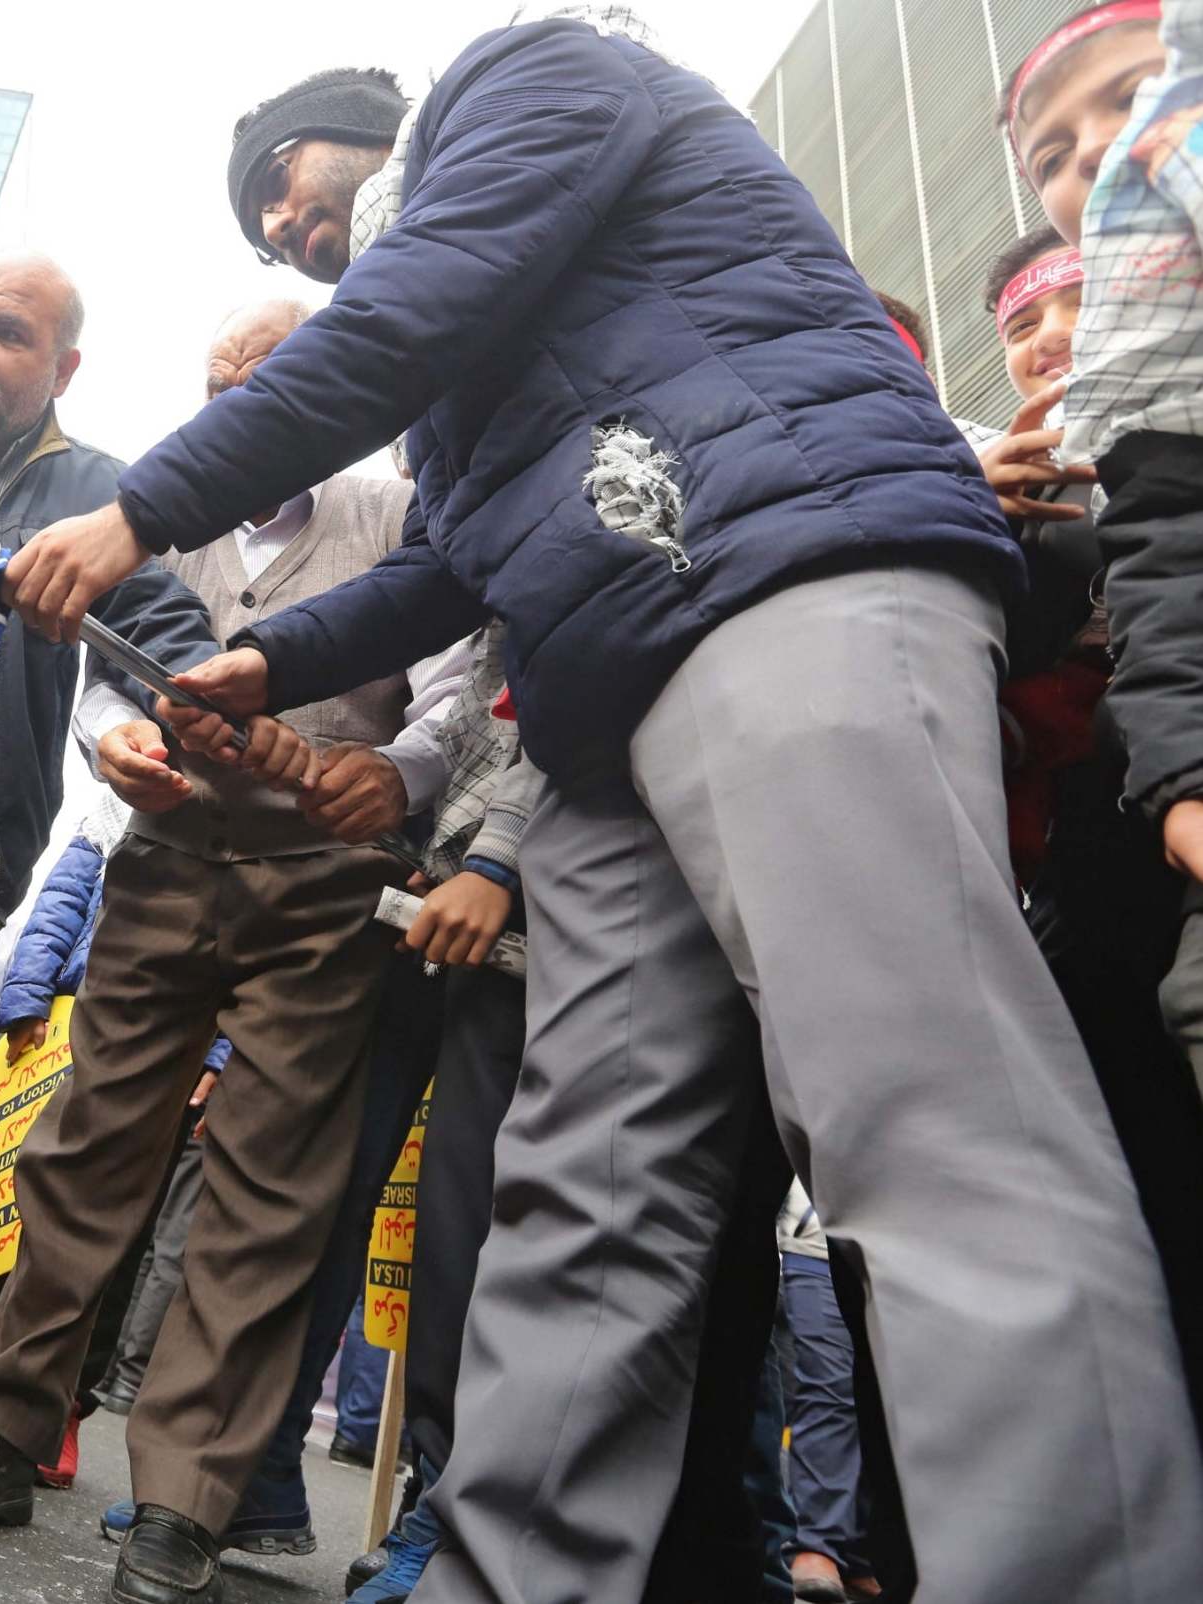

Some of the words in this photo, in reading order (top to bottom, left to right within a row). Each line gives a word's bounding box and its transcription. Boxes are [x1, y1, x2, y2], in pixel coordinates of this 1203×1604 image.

[18, 1071, 65, 1107] Victory
[2, 1102, 15, 1117] to
[380, 1184, 416, 1206] ISRAE
[373, 1263, 404, 1287] U.S.A
[374, 1290, 406, 1337] مرگ
